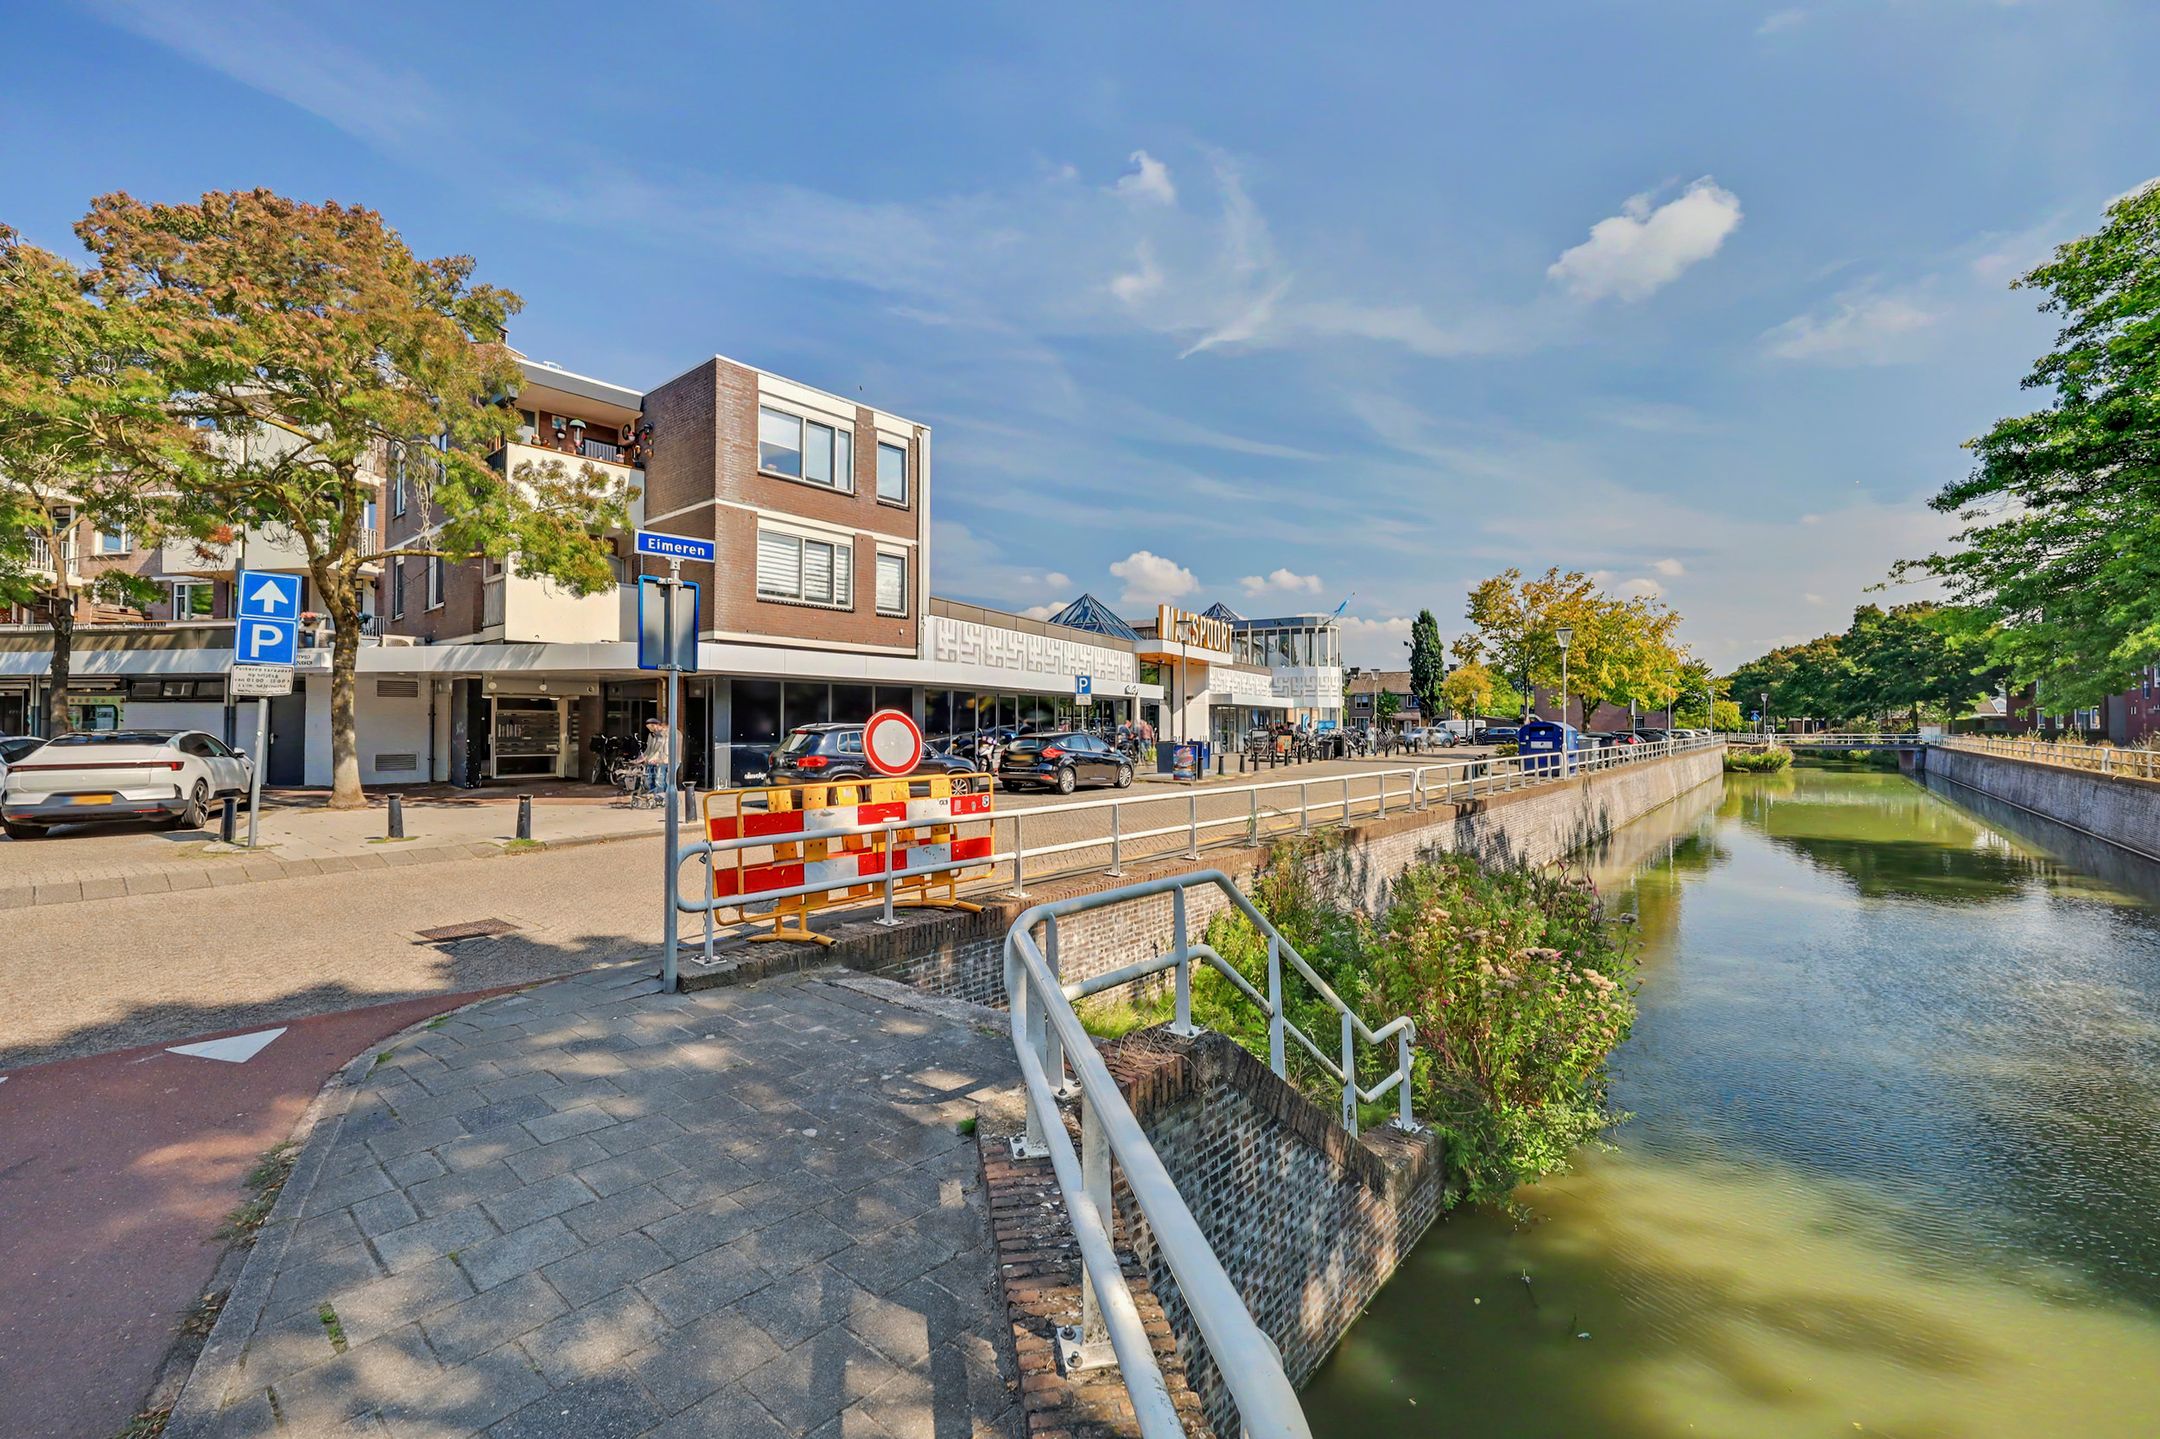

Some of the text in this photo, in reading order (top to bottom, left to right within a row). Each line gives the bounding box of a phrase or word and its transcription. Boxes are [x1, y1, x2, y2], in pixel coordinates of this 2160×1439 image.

[648, 538, 705, 556] Eimeren
[250, 624, 284, 658] P
[1079, 677, 1089, 694] P
